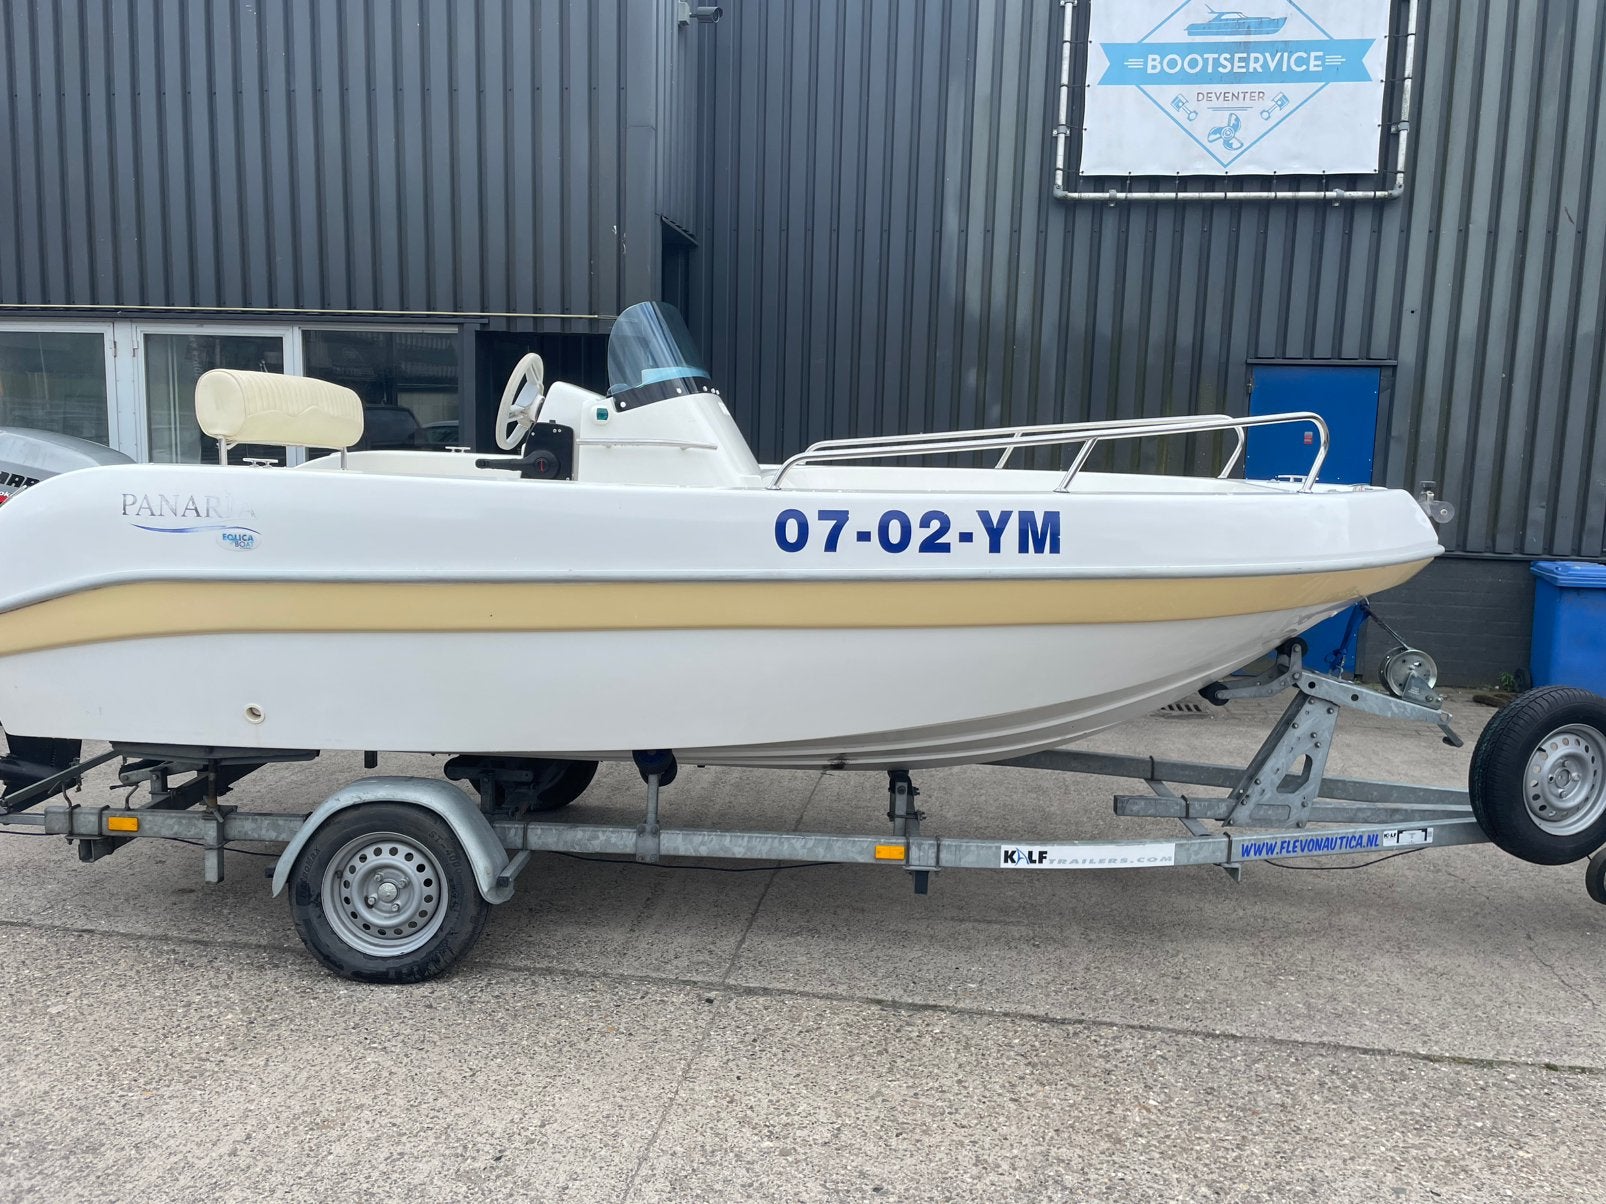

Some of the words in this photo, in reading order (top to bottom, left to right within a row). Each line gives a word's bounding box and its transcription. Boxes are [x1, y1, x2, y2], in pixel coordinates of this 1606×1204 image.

[1147, 51, 1323, 74] BOOTSERVICE
[1196, 91, 1265, 102] DEVENTER
[774, 508, 1061, 554] 07-02-YM
[1241, 834, 1380, 857] WWW.FLEVONAUTICA.NL
